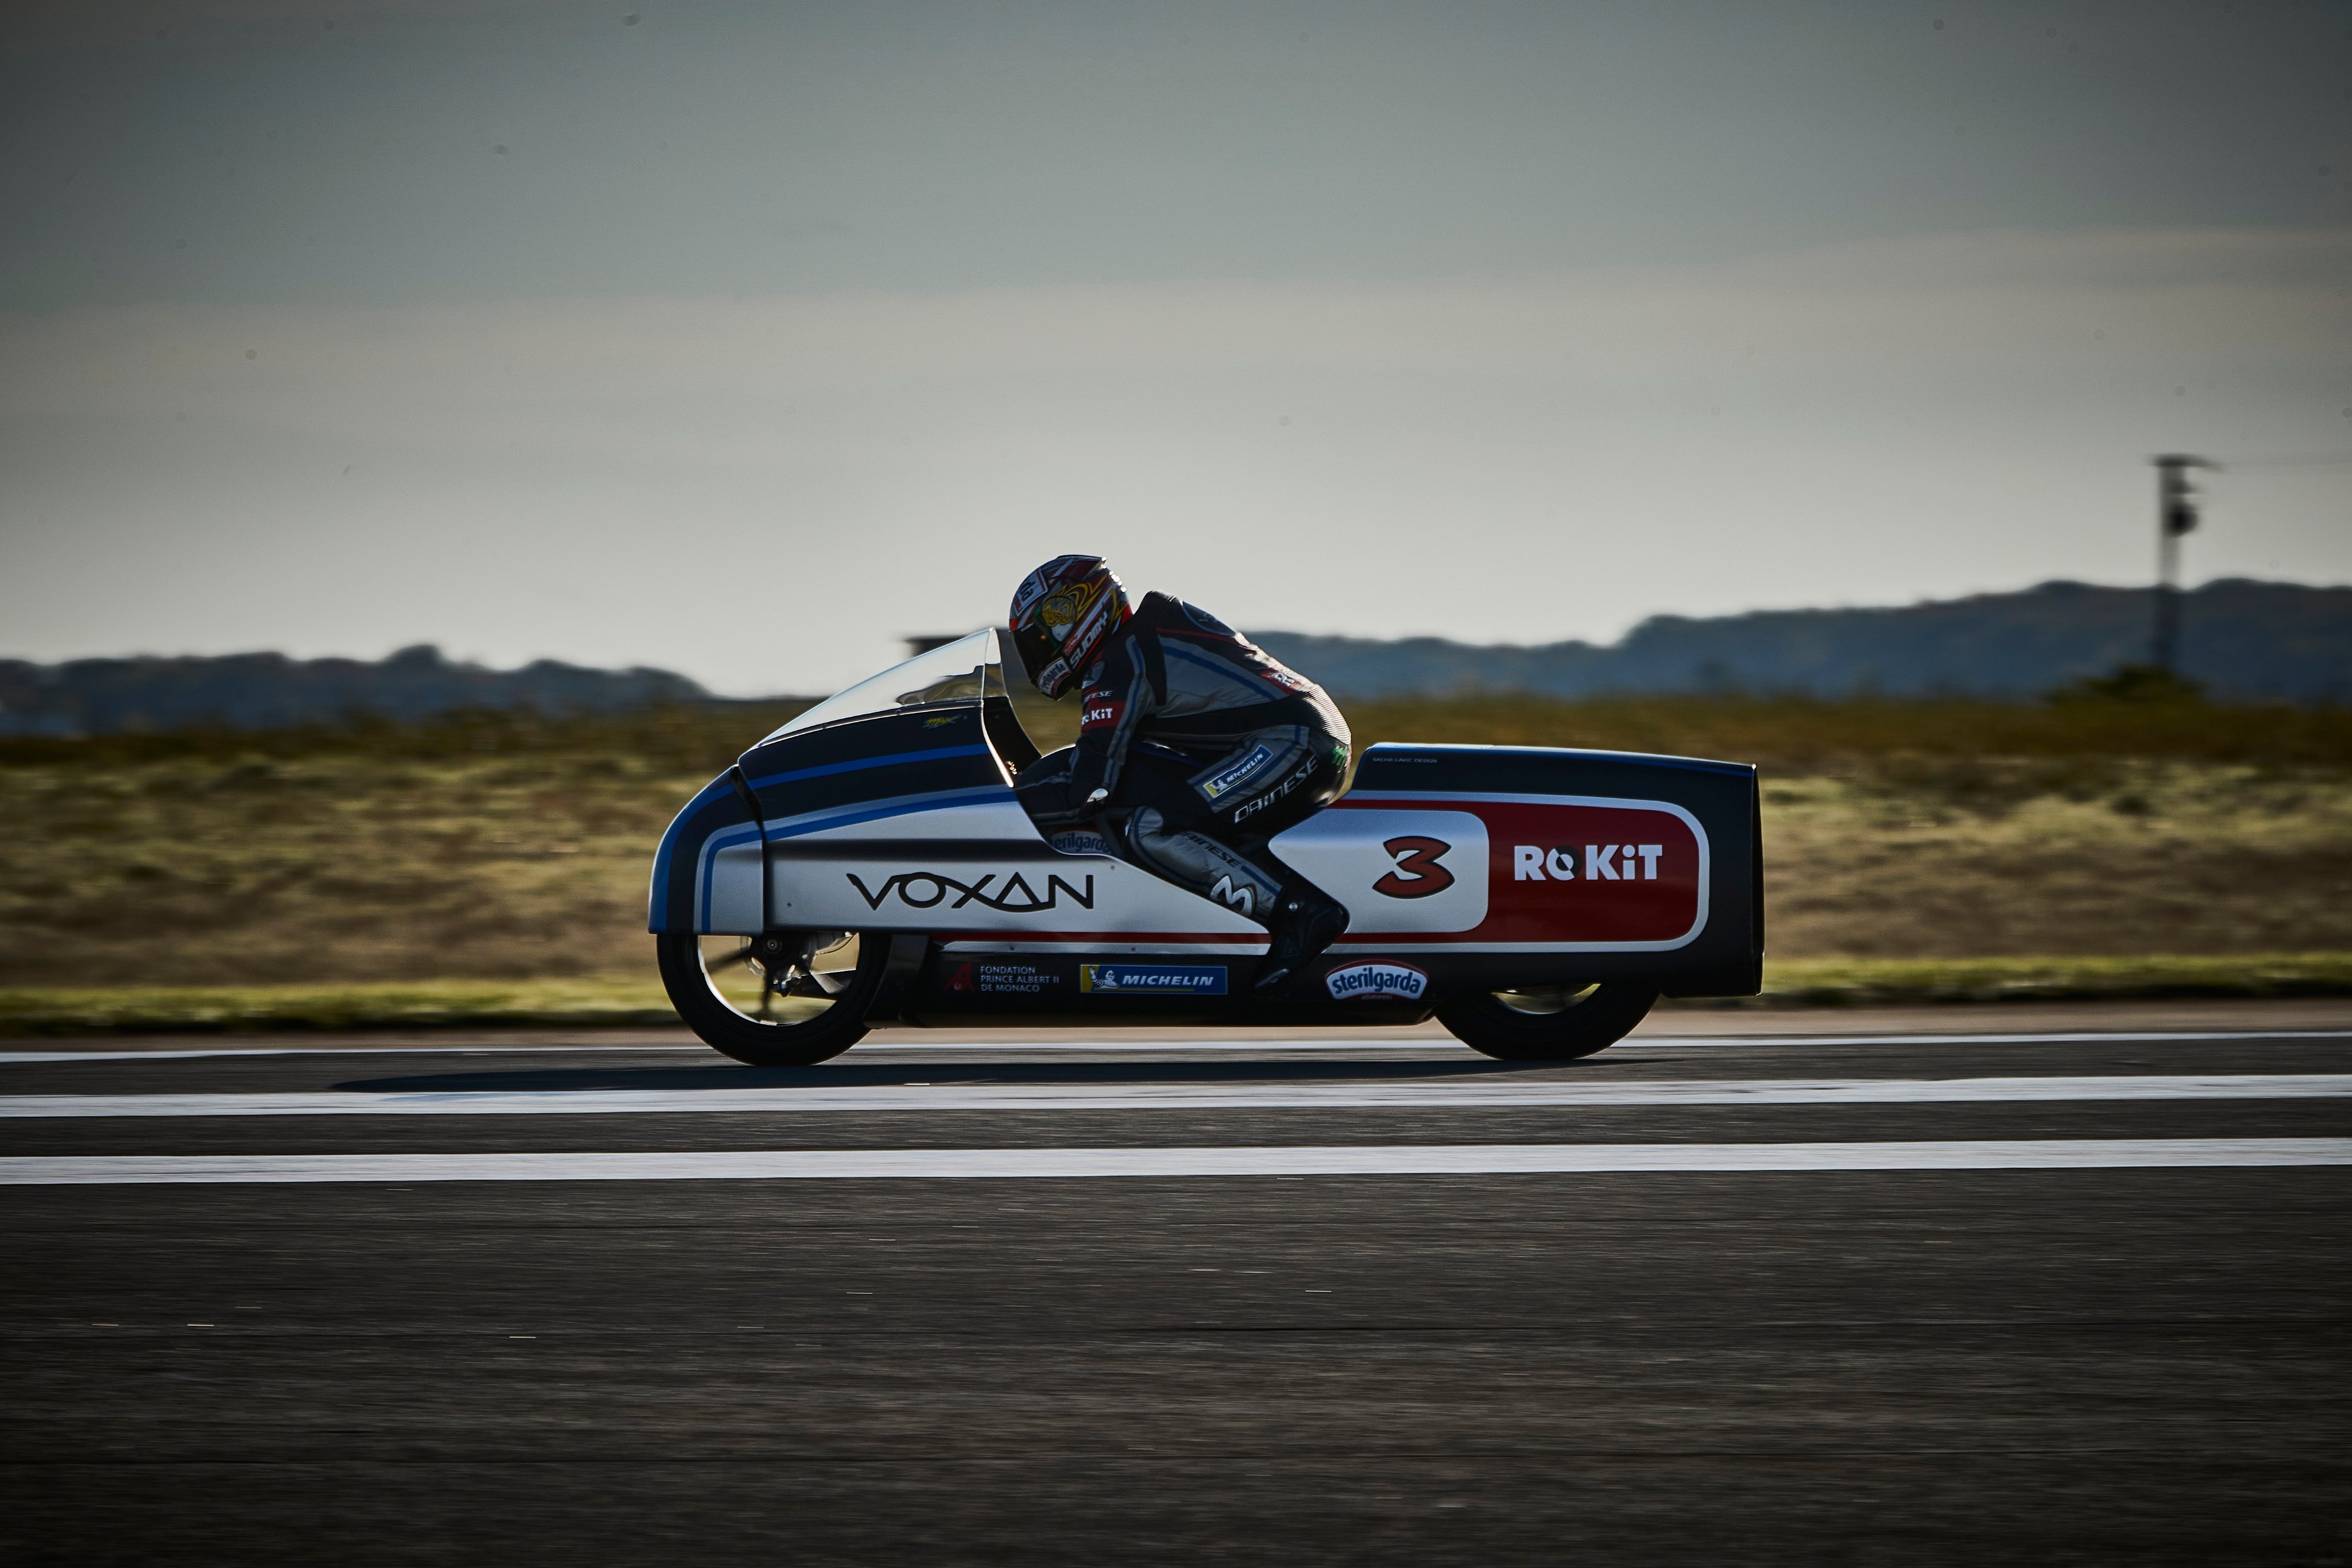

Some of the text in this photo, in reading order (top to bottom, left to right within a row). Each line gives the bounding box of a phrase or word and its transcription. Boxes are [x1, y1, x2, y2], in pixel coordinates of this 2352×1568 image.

[1069, 611, 1108, 669] SUOMY
[1227, 753, 1264, 784] MICHELIN
[1234, 755, 1318, 824] DAINESE
[1373, 836, 1454, 898] 3
[846, 872, 1093, 912] VOXAN
[1123, 975, 1213, 986] MICHELIN
[1332, 967, 1421, 994] sterilgarda
